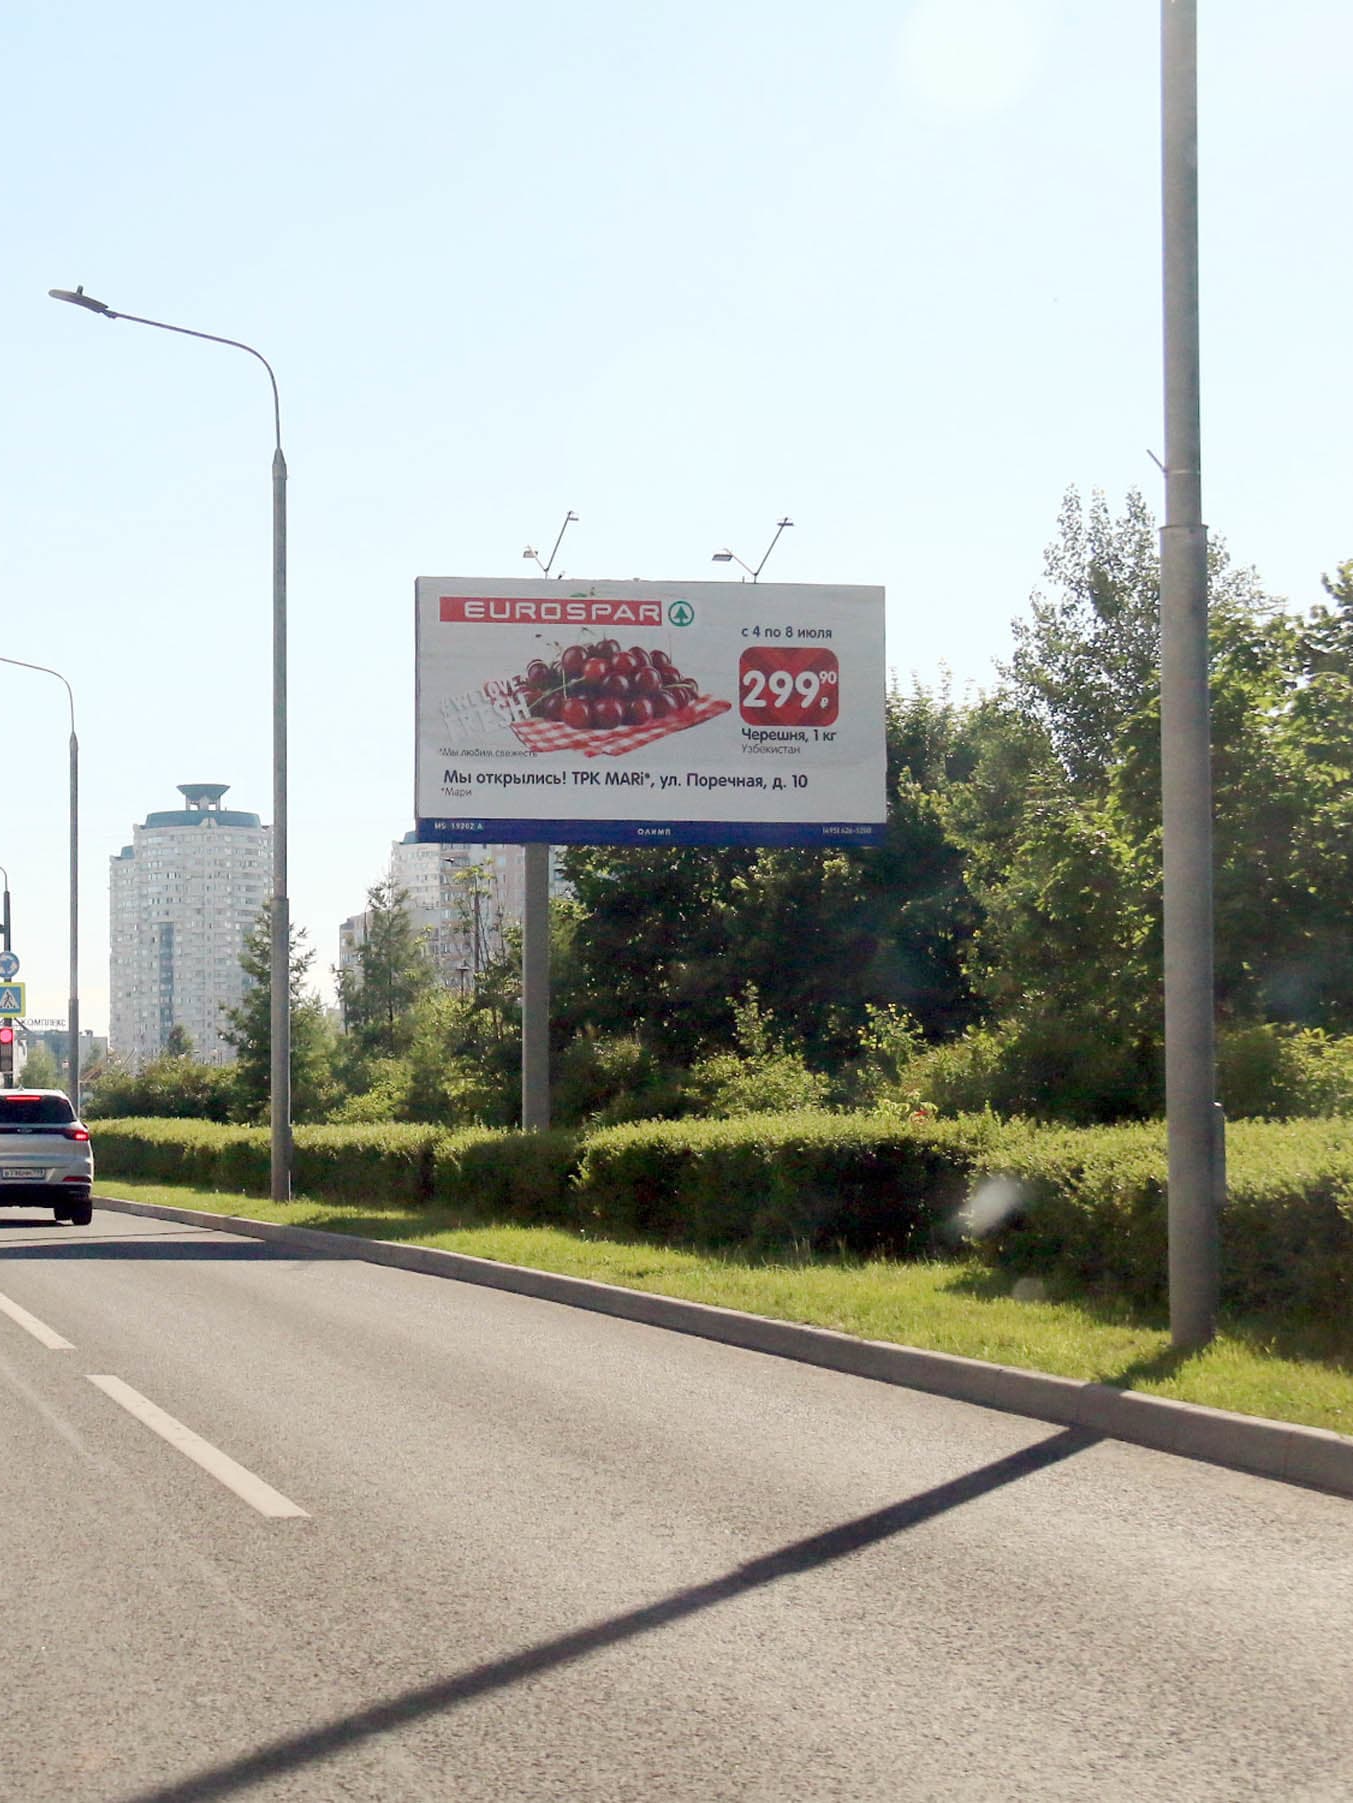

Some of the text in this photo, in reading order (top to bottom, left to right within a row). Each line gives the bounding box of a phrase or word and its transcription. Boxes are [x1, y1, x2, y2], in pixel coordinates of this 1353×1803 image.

[464, 601, 660, 622] EUROSPAR
[752, 625, 761, 638] 4
[764, 627, 782, 638] по
[784, 625, 794, 638] 8
[797, 628, 833, 639] июля
[741, 727, 838, 743] Черешня, 1 кг
[741, 743, 801, 755] Узбекистан
[443, 769, 472, 784] Мы
[476, 771, 567, 788] открылись!
[571, 771, 601, 786] ТРК
[660, 775, 681, 790] ул.
[686, 773, 768, 790] Поречная,
[772, 776, 787, 790] д.
[792, 774, 808, 789] 10
[636, 828, 671, 837] ОЛИМП
